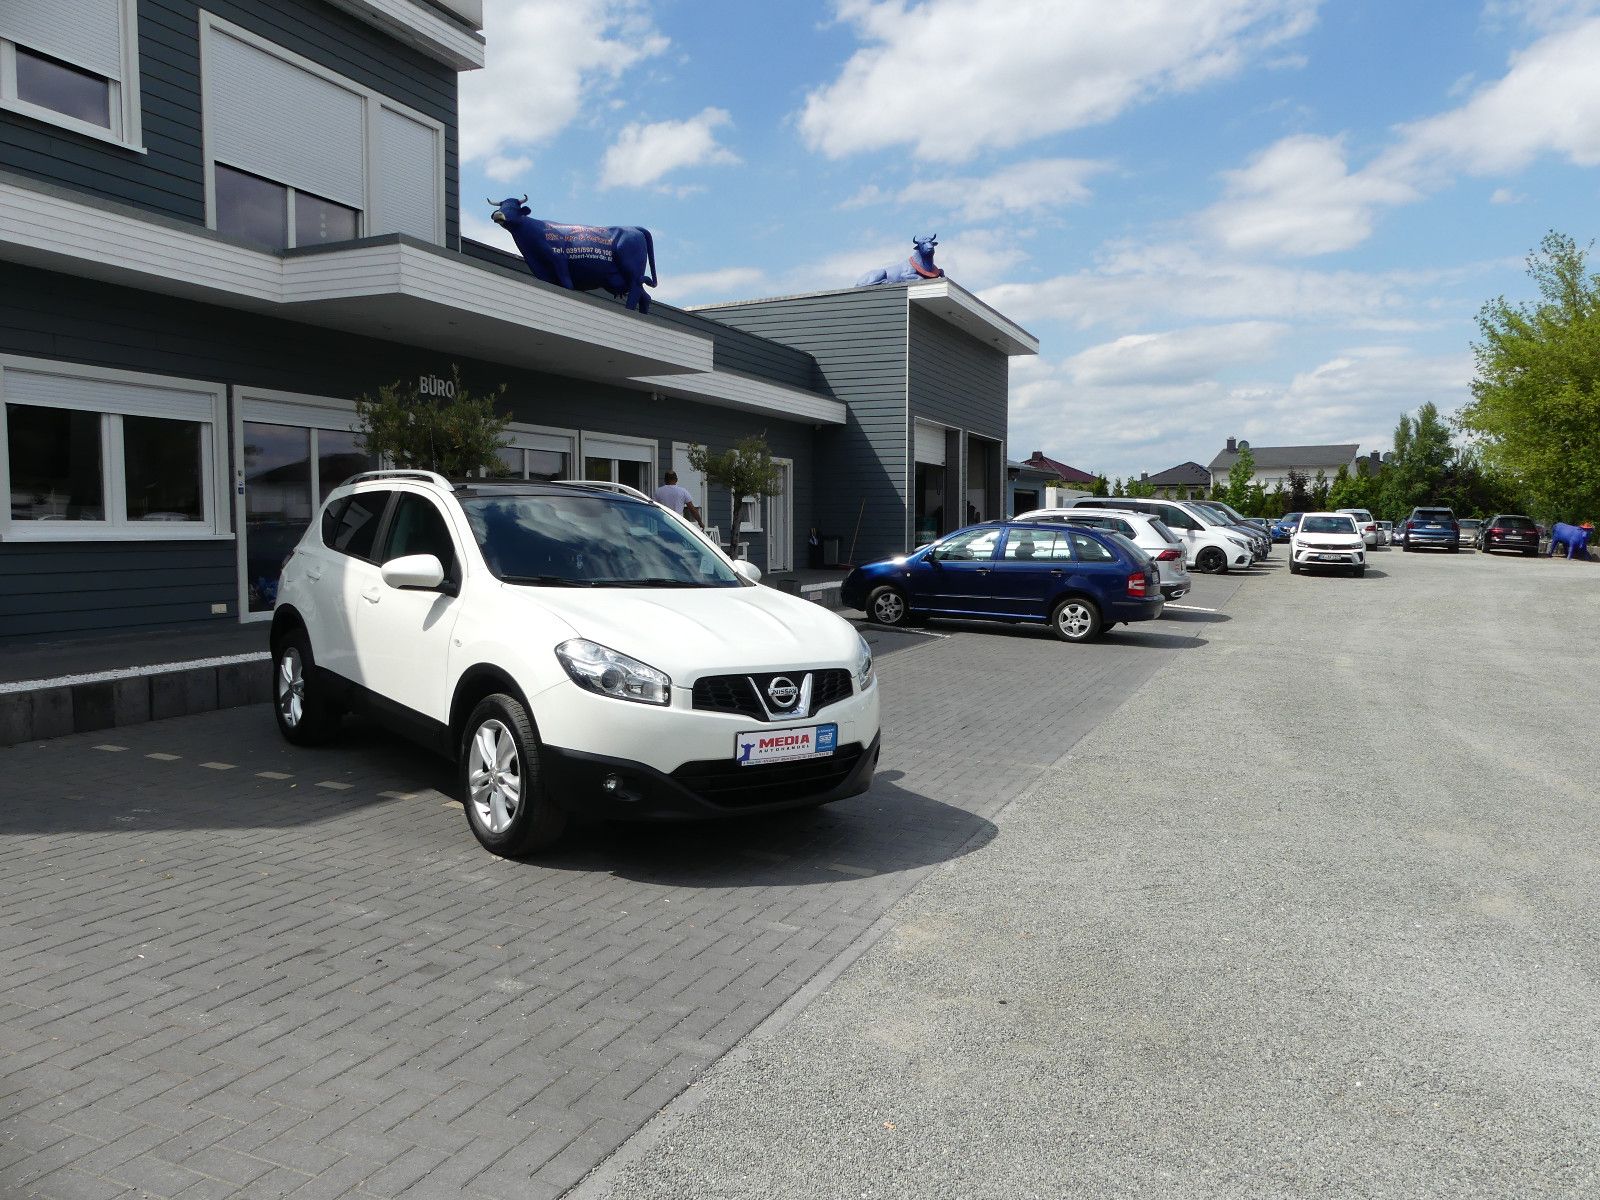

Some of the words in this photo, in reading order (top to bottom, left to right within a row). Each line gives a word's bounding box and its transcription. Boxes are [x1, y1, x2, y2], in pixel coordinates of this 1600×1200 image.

[420, 374, 455, 398] BÜRO
[759, 734, 810, 749] MEDIA
[759, 744, 810, 753] AUTOHANDEL
